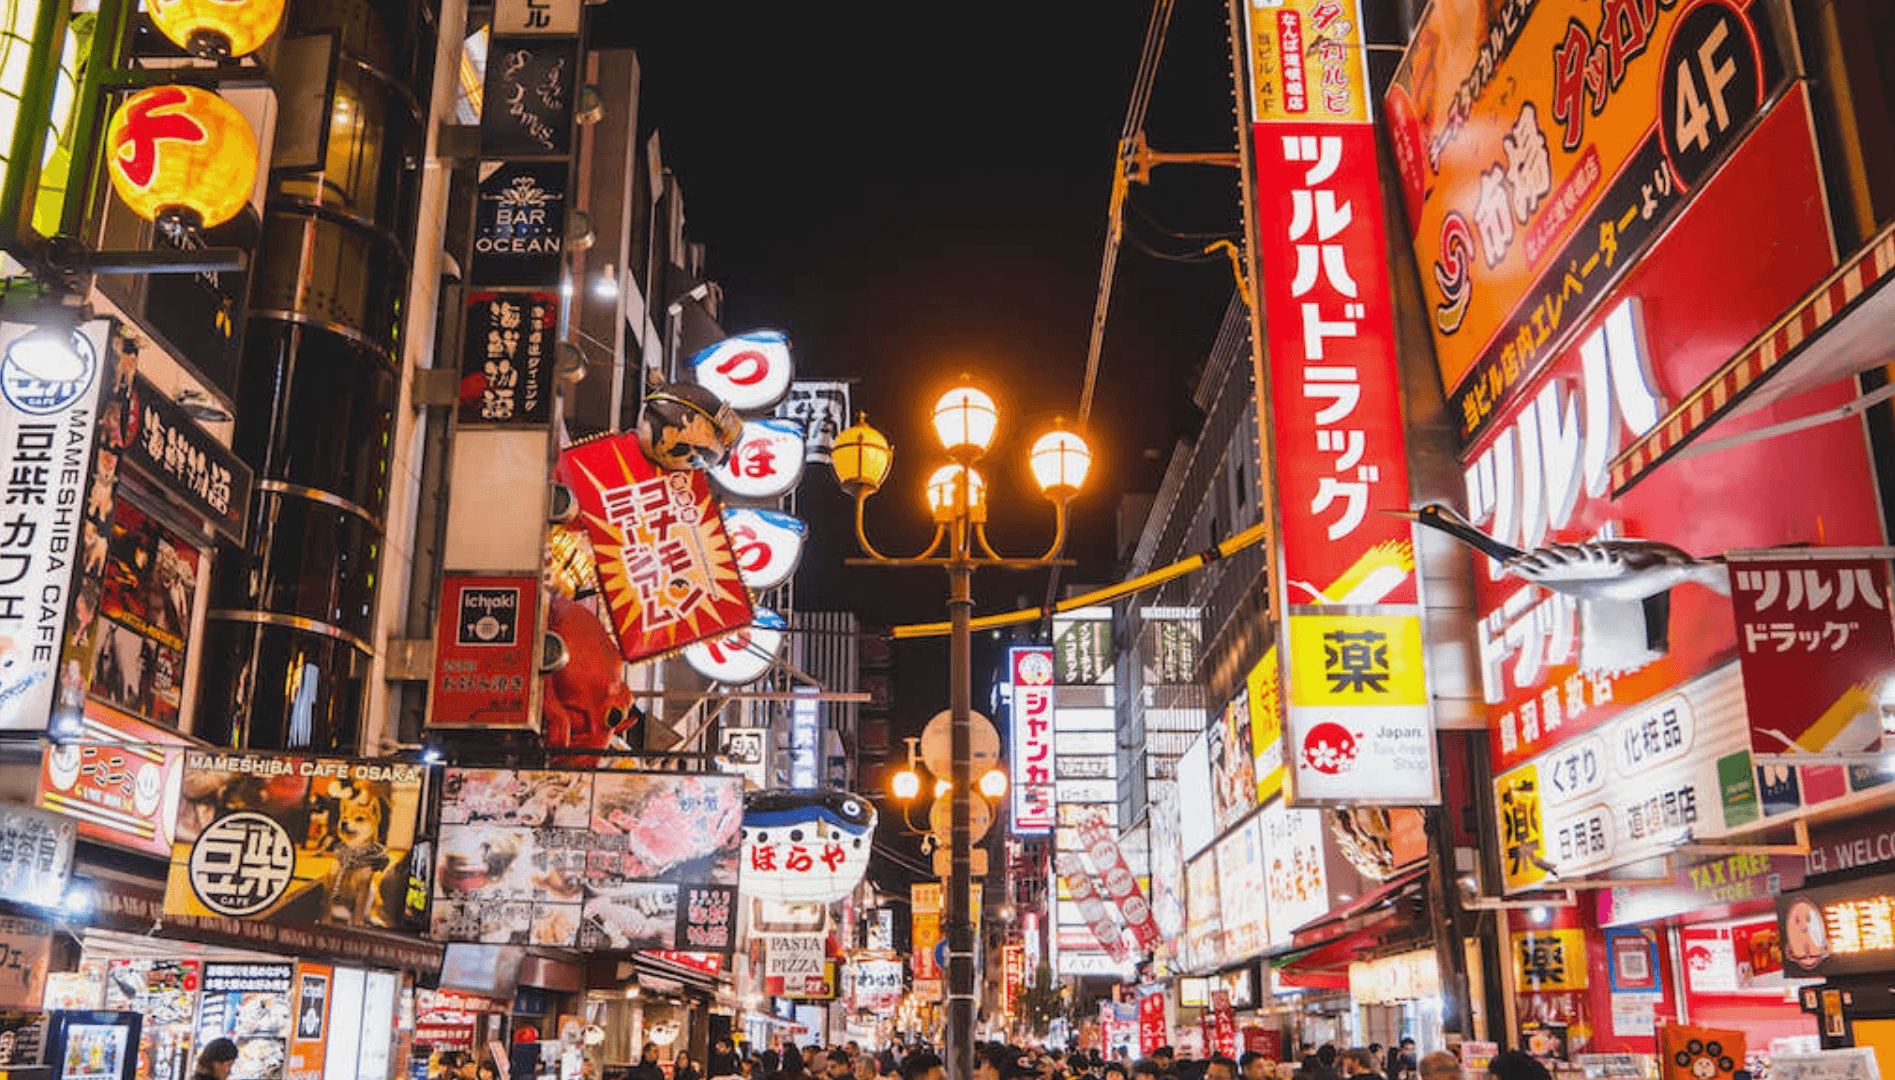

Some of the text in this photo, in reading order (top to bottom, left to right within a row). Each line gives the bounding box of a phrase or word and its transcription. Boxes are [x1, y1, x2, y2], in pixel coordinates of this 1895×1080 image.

[525, 0, 550, 28] ル
[1674, 19, 1738, 154] 4F
[496, 208, 546, 225] BAR
[476, 237, 561, 252] OCEAN
[1461, 161, 1671, 432] 当ビル店内エレベーターより
[1281, 135, 1379, 541] ツルハドラッグ
[32, 409, 89, 663] MAMESHIBA CAFE
[1736, 568, 1884, 612] ツルハ
[1744, 620, 1860, 654] ドラッグ
[1323, 630, 1391, 695] 薬
[1025, 690, 1049, 815] ジャンカラ
[1625, 708, 1682, 764] 化粧品
[189, 755, 417, 783] MAMESHIBA CAFE OSAKA
[1552, 749, 1597, 792] くすり
[1502, 778, 1558, 878] 薬
[1559, 817, 1604, 861] 日用品
[1691, 853, 1771, 891] TAX FREE
[221, 896, 250, 907] CAFE
[772, 937, 821, 951] PASTA
[772, 959, 820, 973] PIZZA
[1521, 936, 1565, 985] 薬
